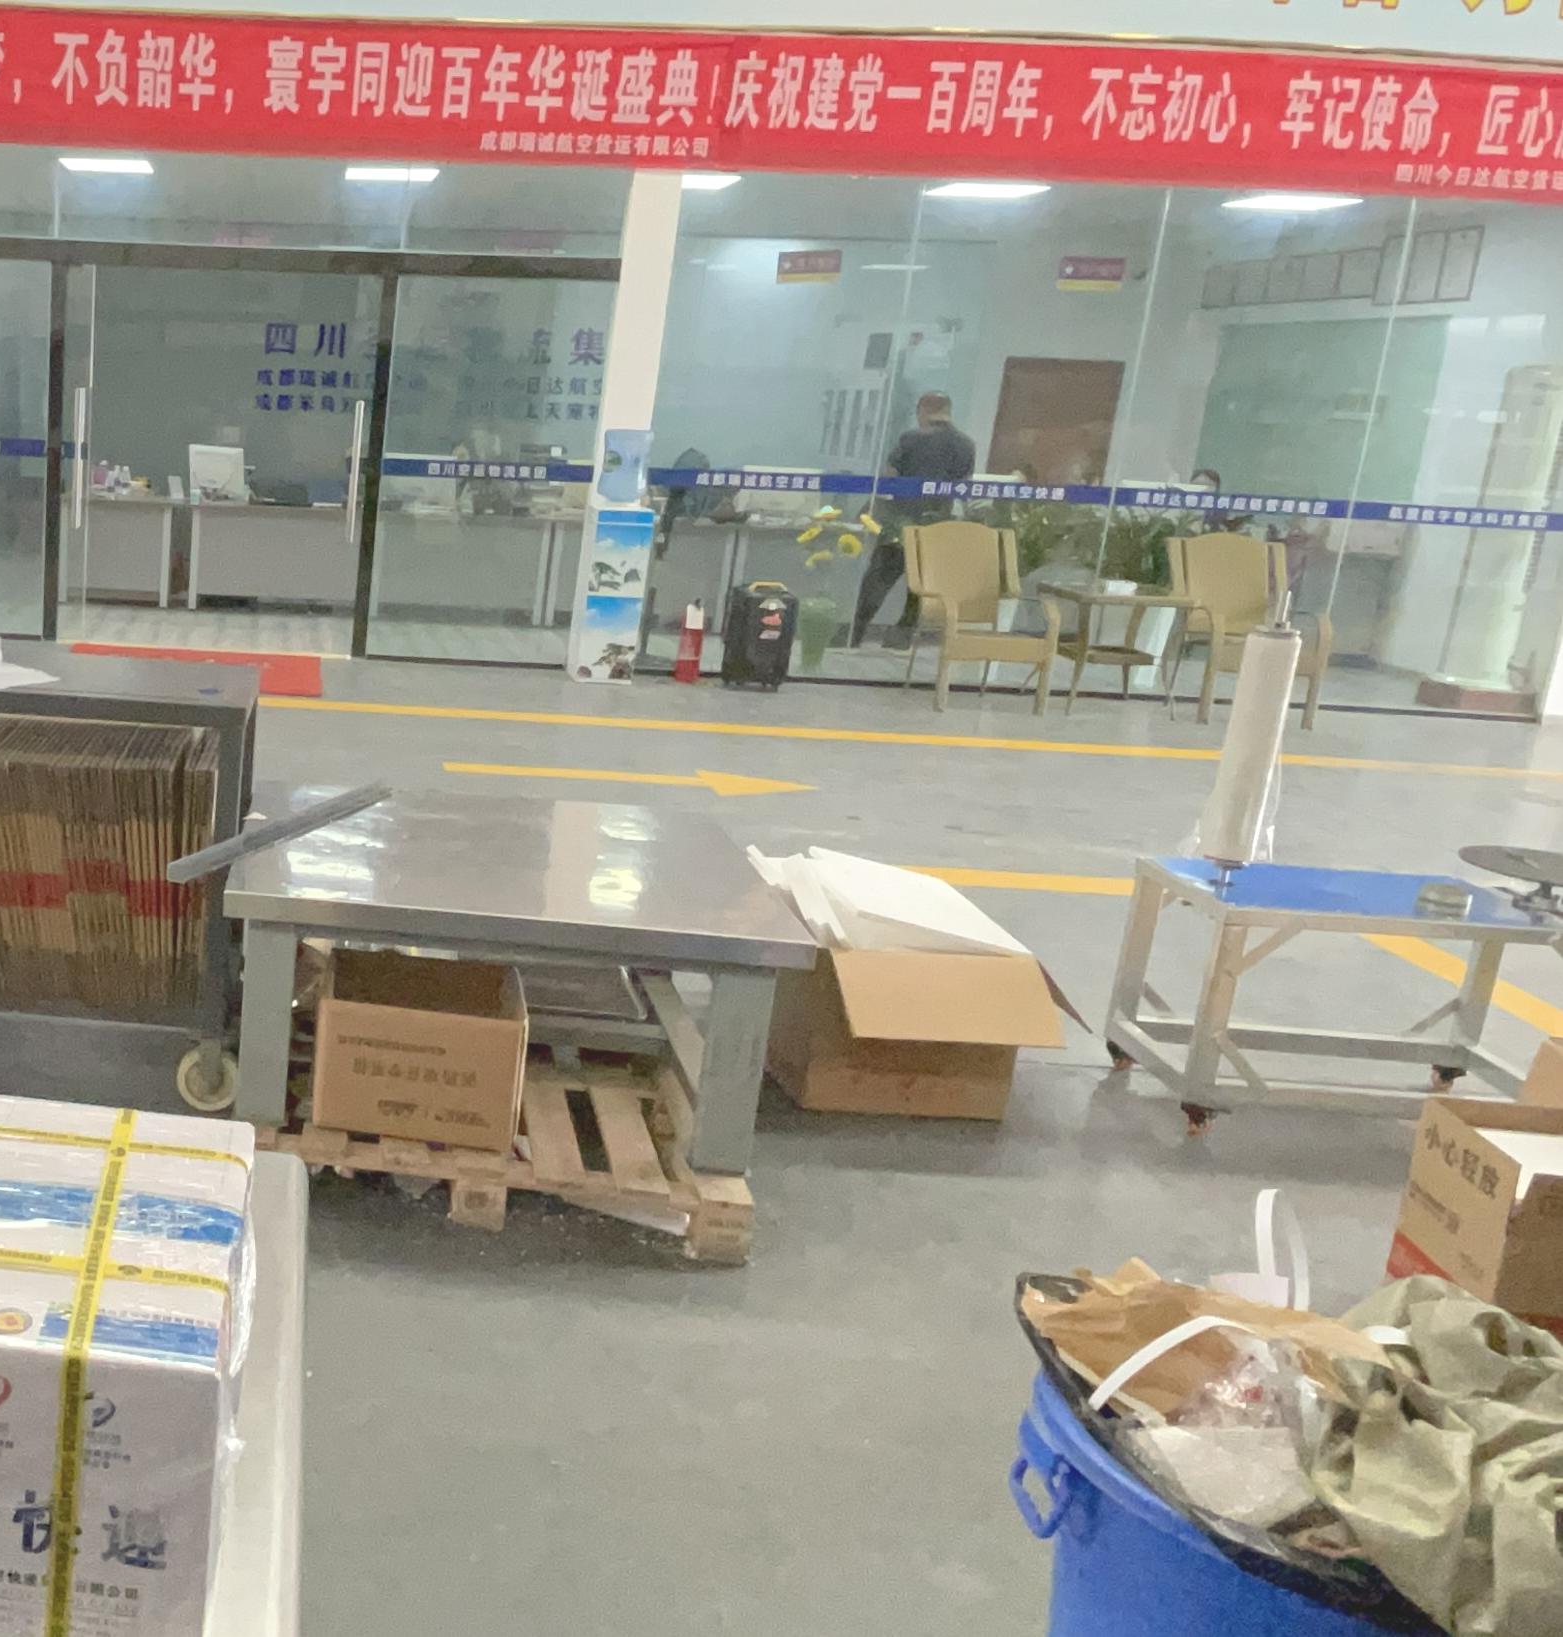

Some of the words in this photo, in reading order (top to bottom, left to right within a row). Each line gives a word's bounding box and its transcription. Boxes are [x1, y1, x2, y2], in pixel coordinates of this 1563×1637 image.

[724, 50, 1563, 158] 庆祝建党一百周年，不忘初心，牢记使命，匠心
